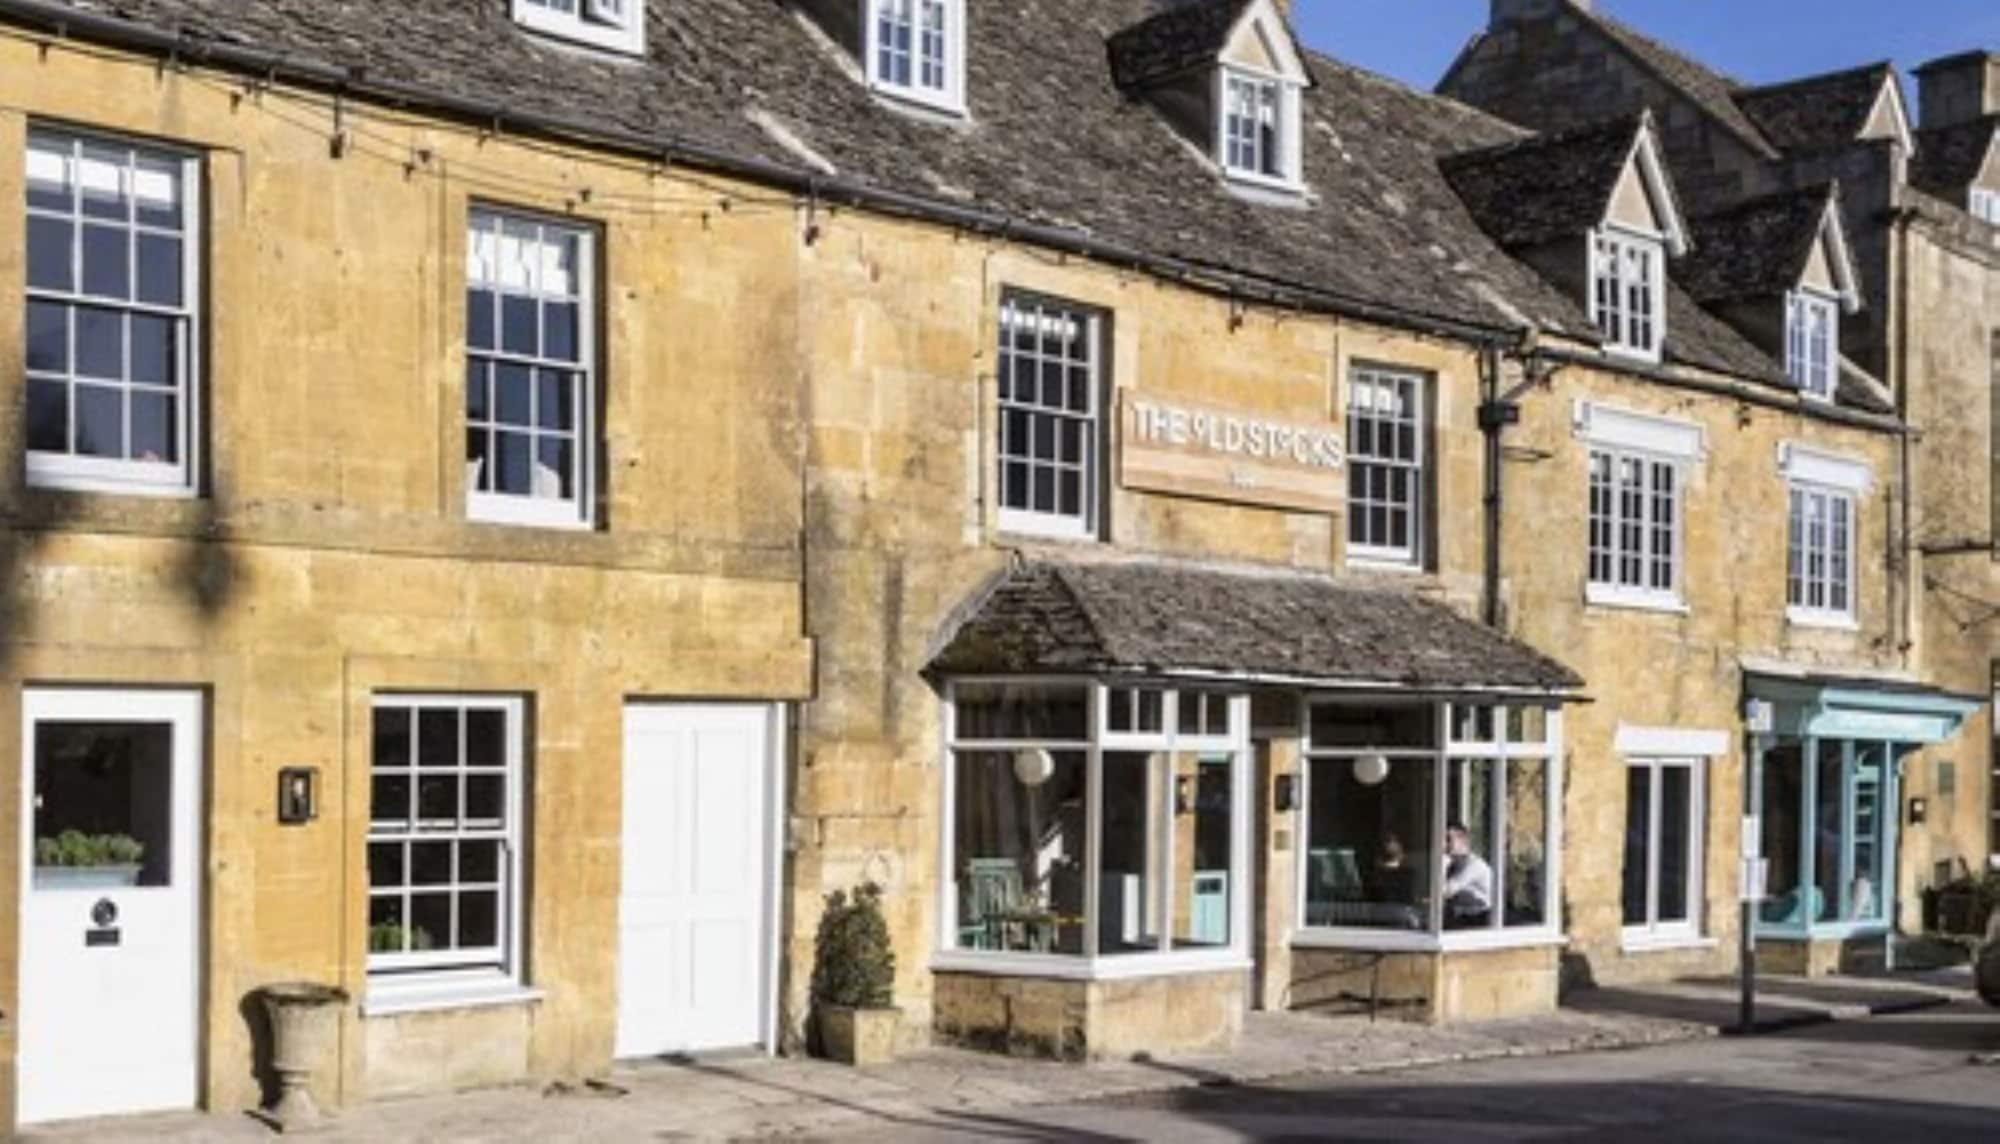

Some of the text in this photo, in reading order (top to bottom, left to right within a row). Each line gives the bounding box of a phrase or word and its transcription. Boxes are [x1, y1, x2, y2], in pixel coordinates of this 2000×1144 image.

[1133, 402, 1343, 468] THE OLD STOCKS
